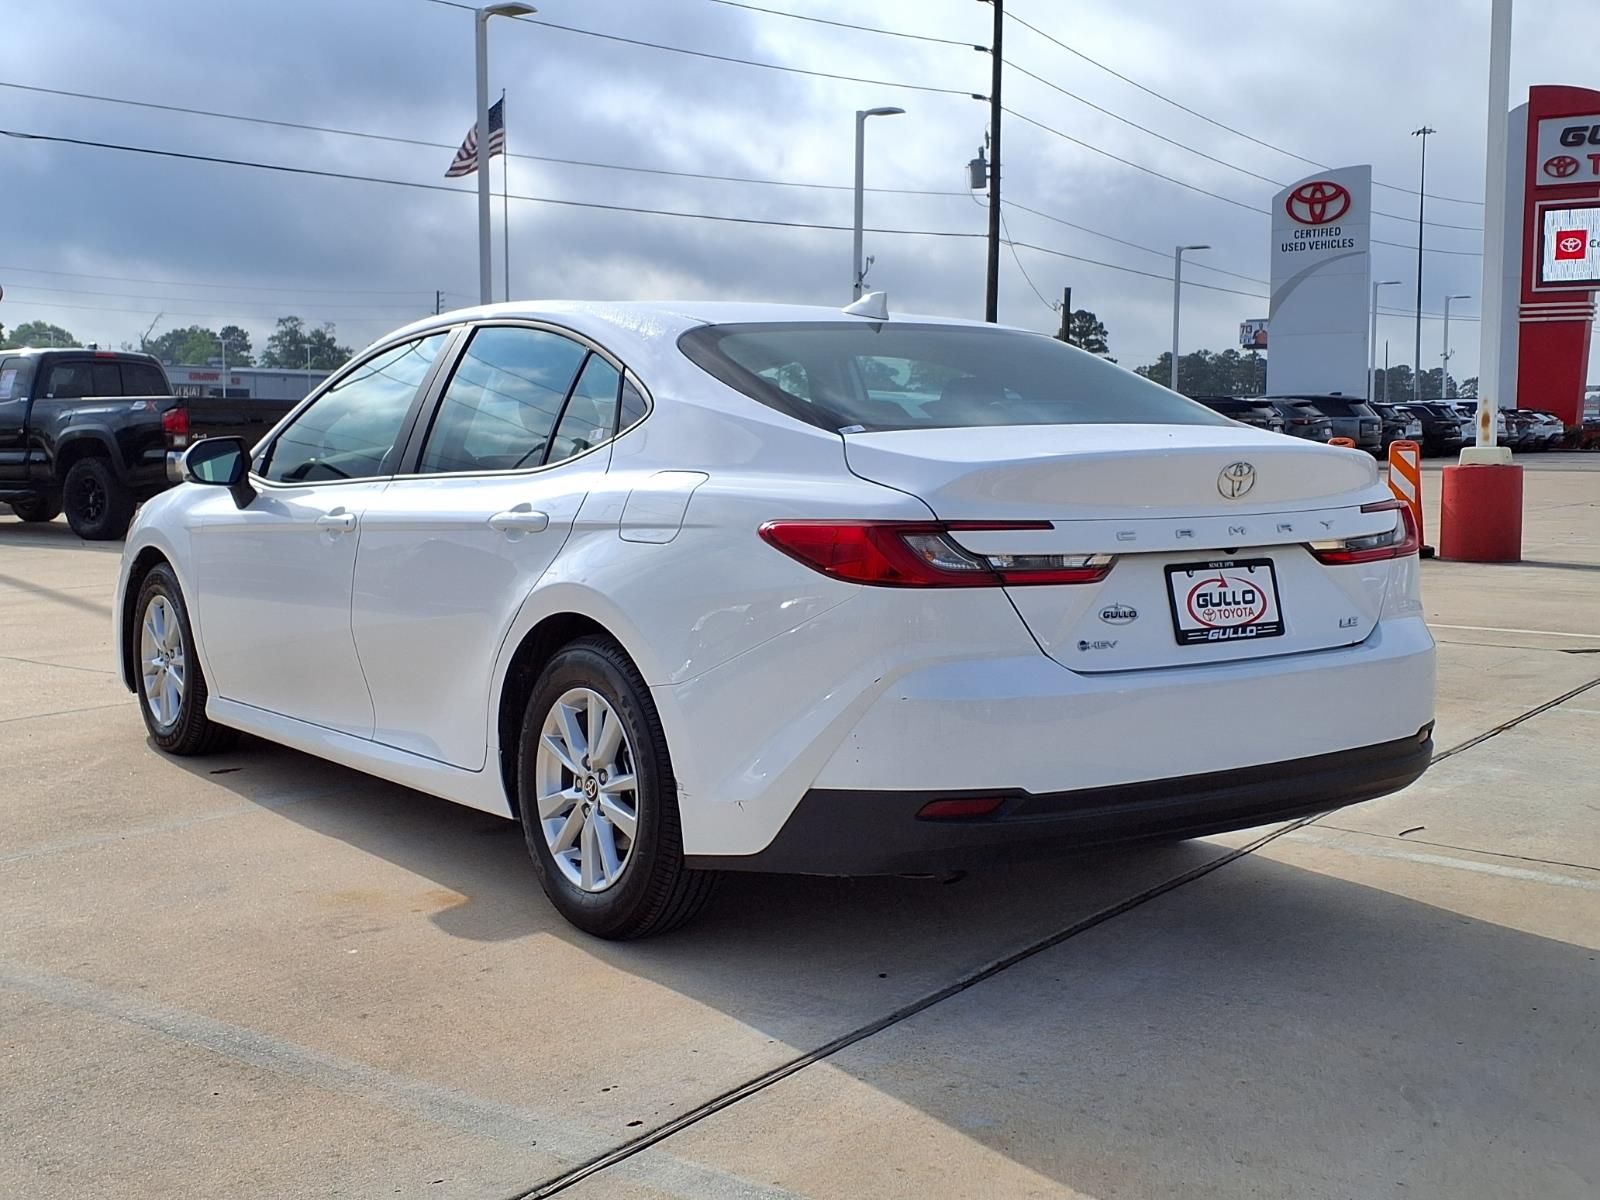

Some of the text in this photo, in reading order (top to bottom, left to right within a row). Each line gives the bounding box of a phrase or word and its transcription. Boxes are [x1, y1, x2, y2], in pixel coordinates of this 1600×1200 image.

[1294, 227, 1341, 239] CERTIFIED
[1281, 239, 1354, 252] USED VEHICLES
[1116, 520, 1334, 541] CAMRY
[1196, 589, 1256, 608] GULLO
[1103, 610, 1137, 619] GULLO
[1217, 607, 1255, 619] TOYOTA
[1339, 616, 1358, 628] LE
[1208, 626, 1257, 640] GULLO
